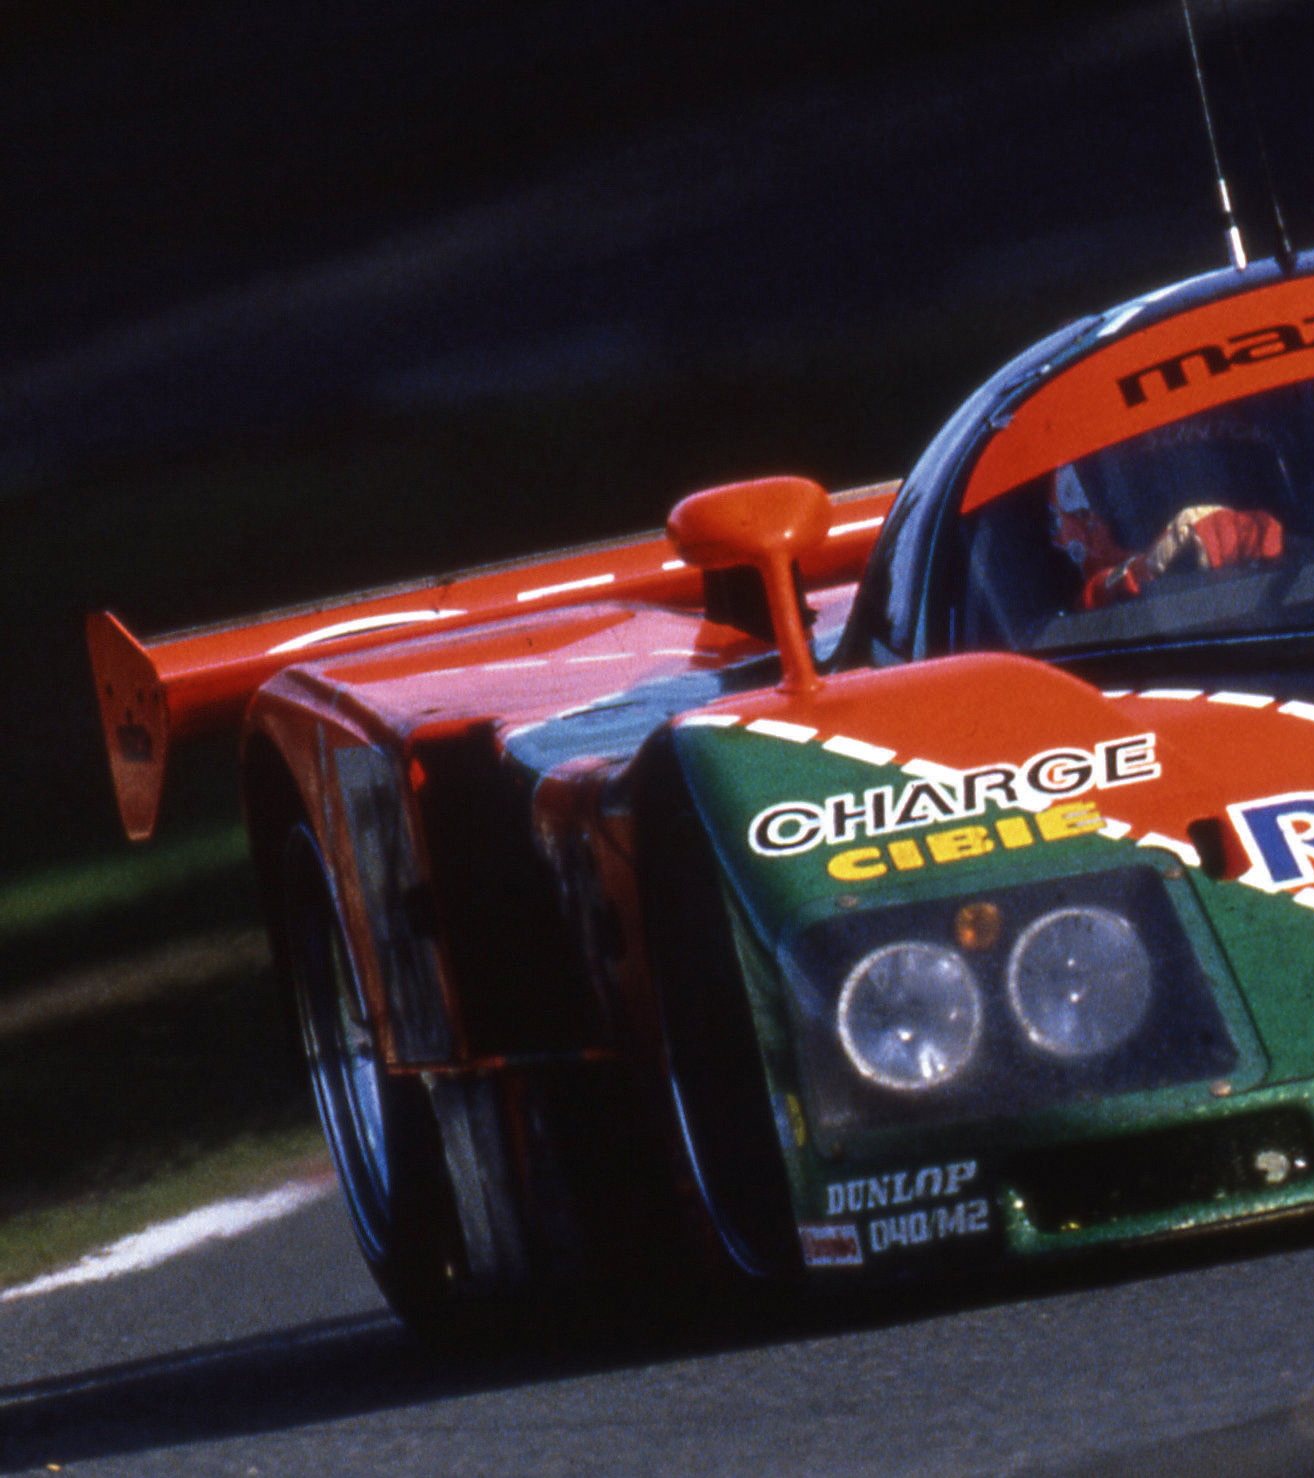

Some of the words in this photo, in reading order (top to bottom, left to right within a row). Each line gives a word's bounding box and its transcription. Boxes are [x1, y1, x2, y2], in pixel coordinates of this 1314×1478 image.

[748, 732, 1162, 857] CHARGE
[827, 800, 1108, 881] CIBIE
[826, 1160, 977, 1216] DUNLOP
